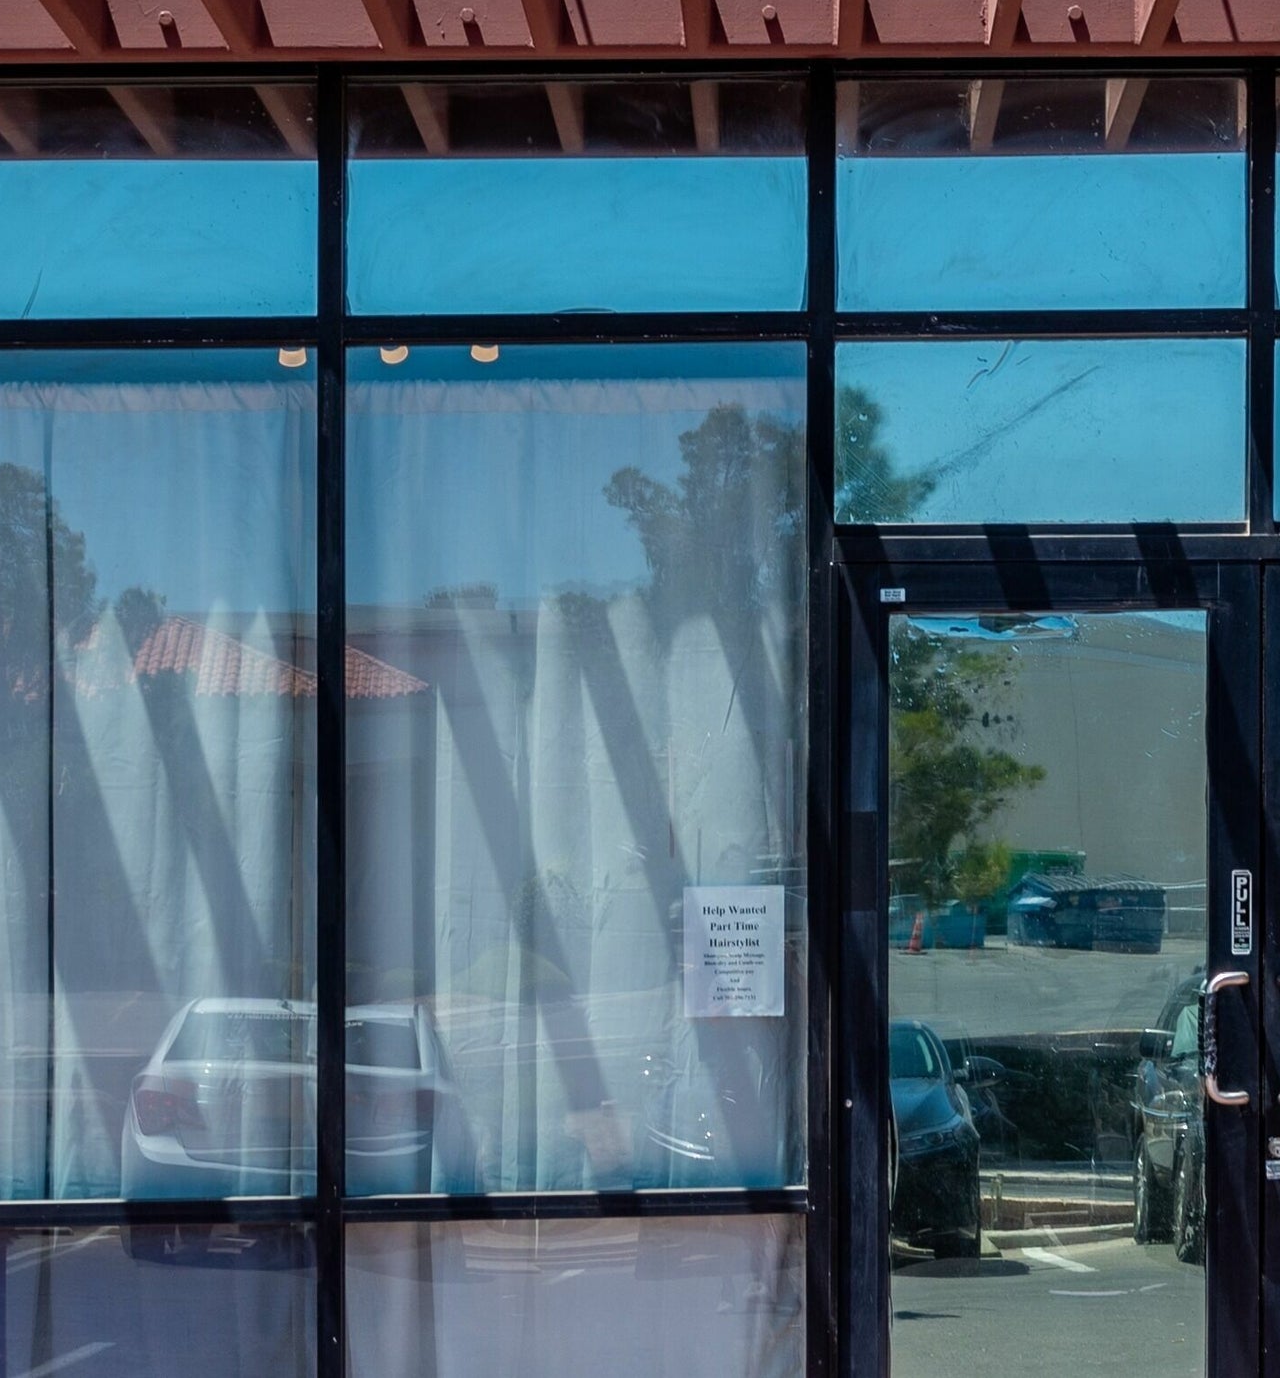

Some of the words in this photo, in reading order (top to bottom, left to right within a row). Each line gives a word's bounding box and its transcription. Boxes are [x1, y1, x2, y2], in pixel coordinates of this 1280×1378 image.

[1236, 876, 1248, 927] PULL
[703, 906, 726, 917] Help
[728, 905, 767, 914] Wanted
[710, 922, 731, 931] Part
[733, 921, 760, 931] Time
[709, 938, 760, 949] Hairstylist
